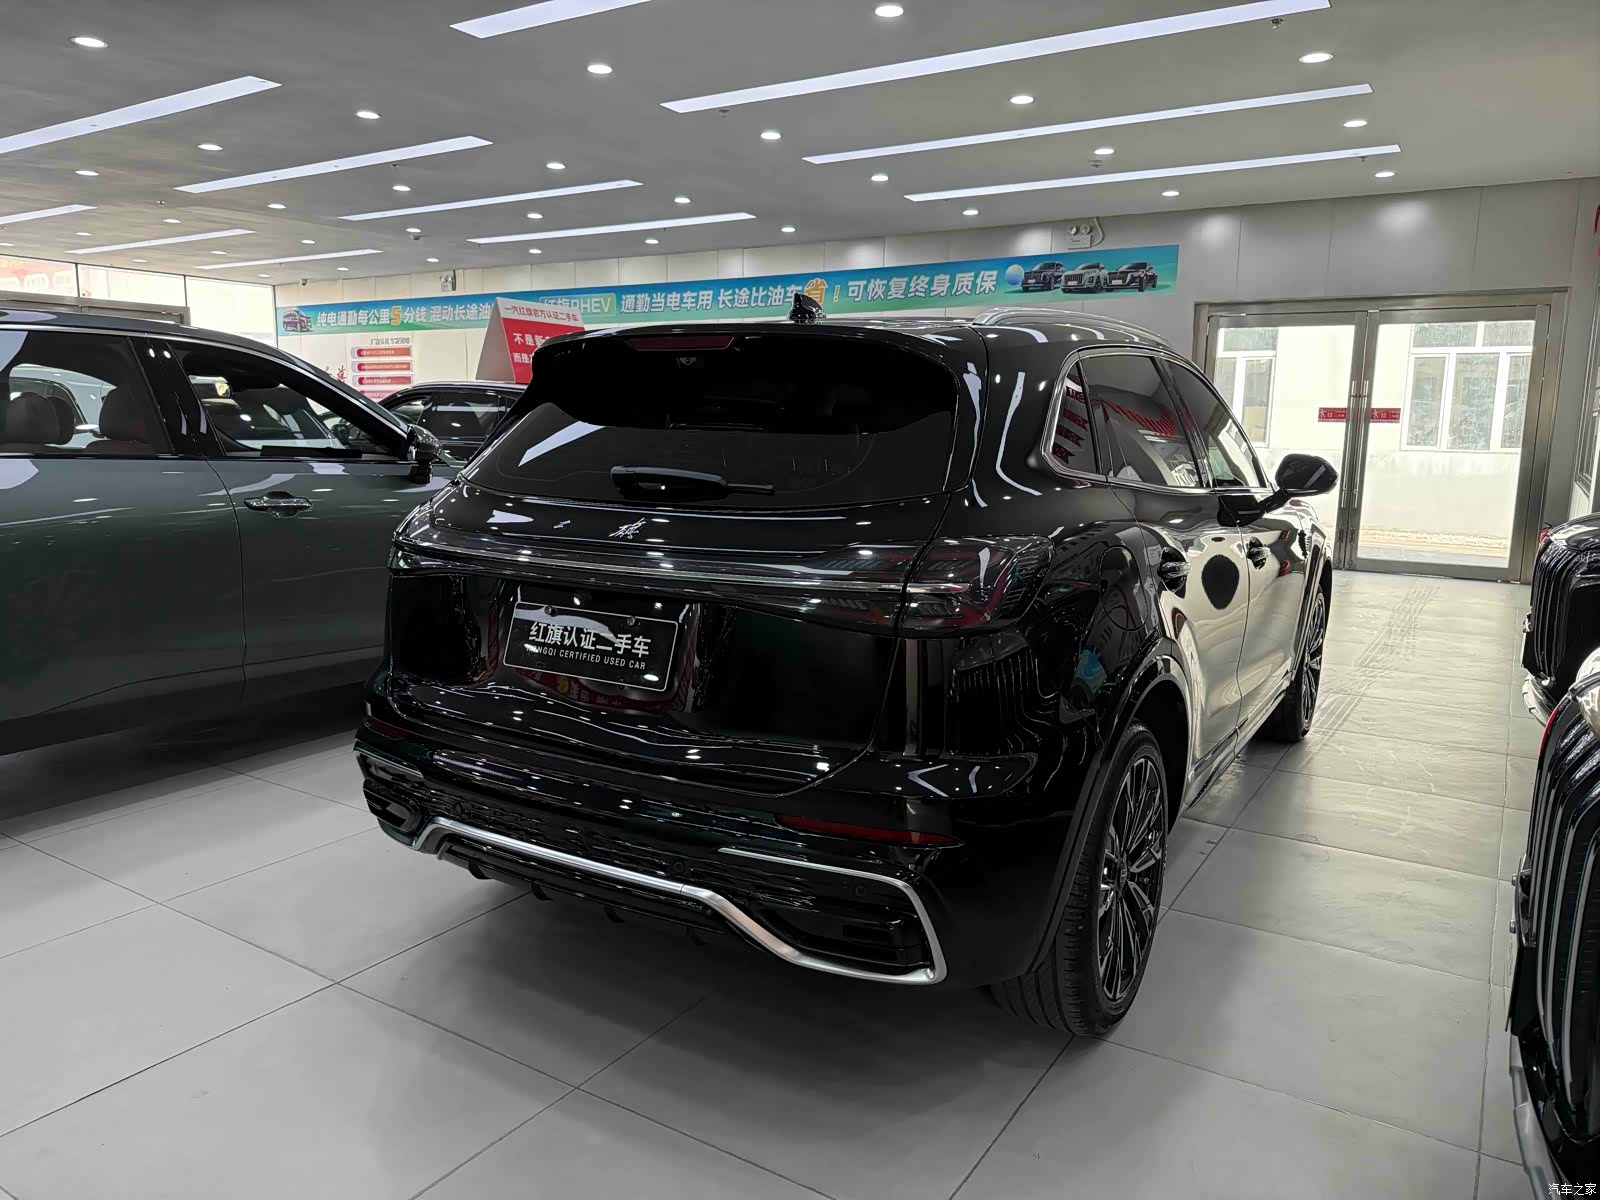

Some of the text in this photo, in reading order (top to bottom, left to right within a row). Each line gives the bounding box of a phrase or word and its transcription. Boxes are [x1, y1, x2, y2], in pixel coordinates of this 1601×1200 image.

[620, 287, 713, 313] 通勤当电车用
[430, 302, 494, 323] 混动长途油
[504, 305, 579, 322] 一汽红旗官方认证二手车
[513, 332, 549, 347] 不是新
[528, 621, 652, 658] 红旗认证二手车
[526, 644, 646, 670] NGQI CERTIFIED USED CAR
